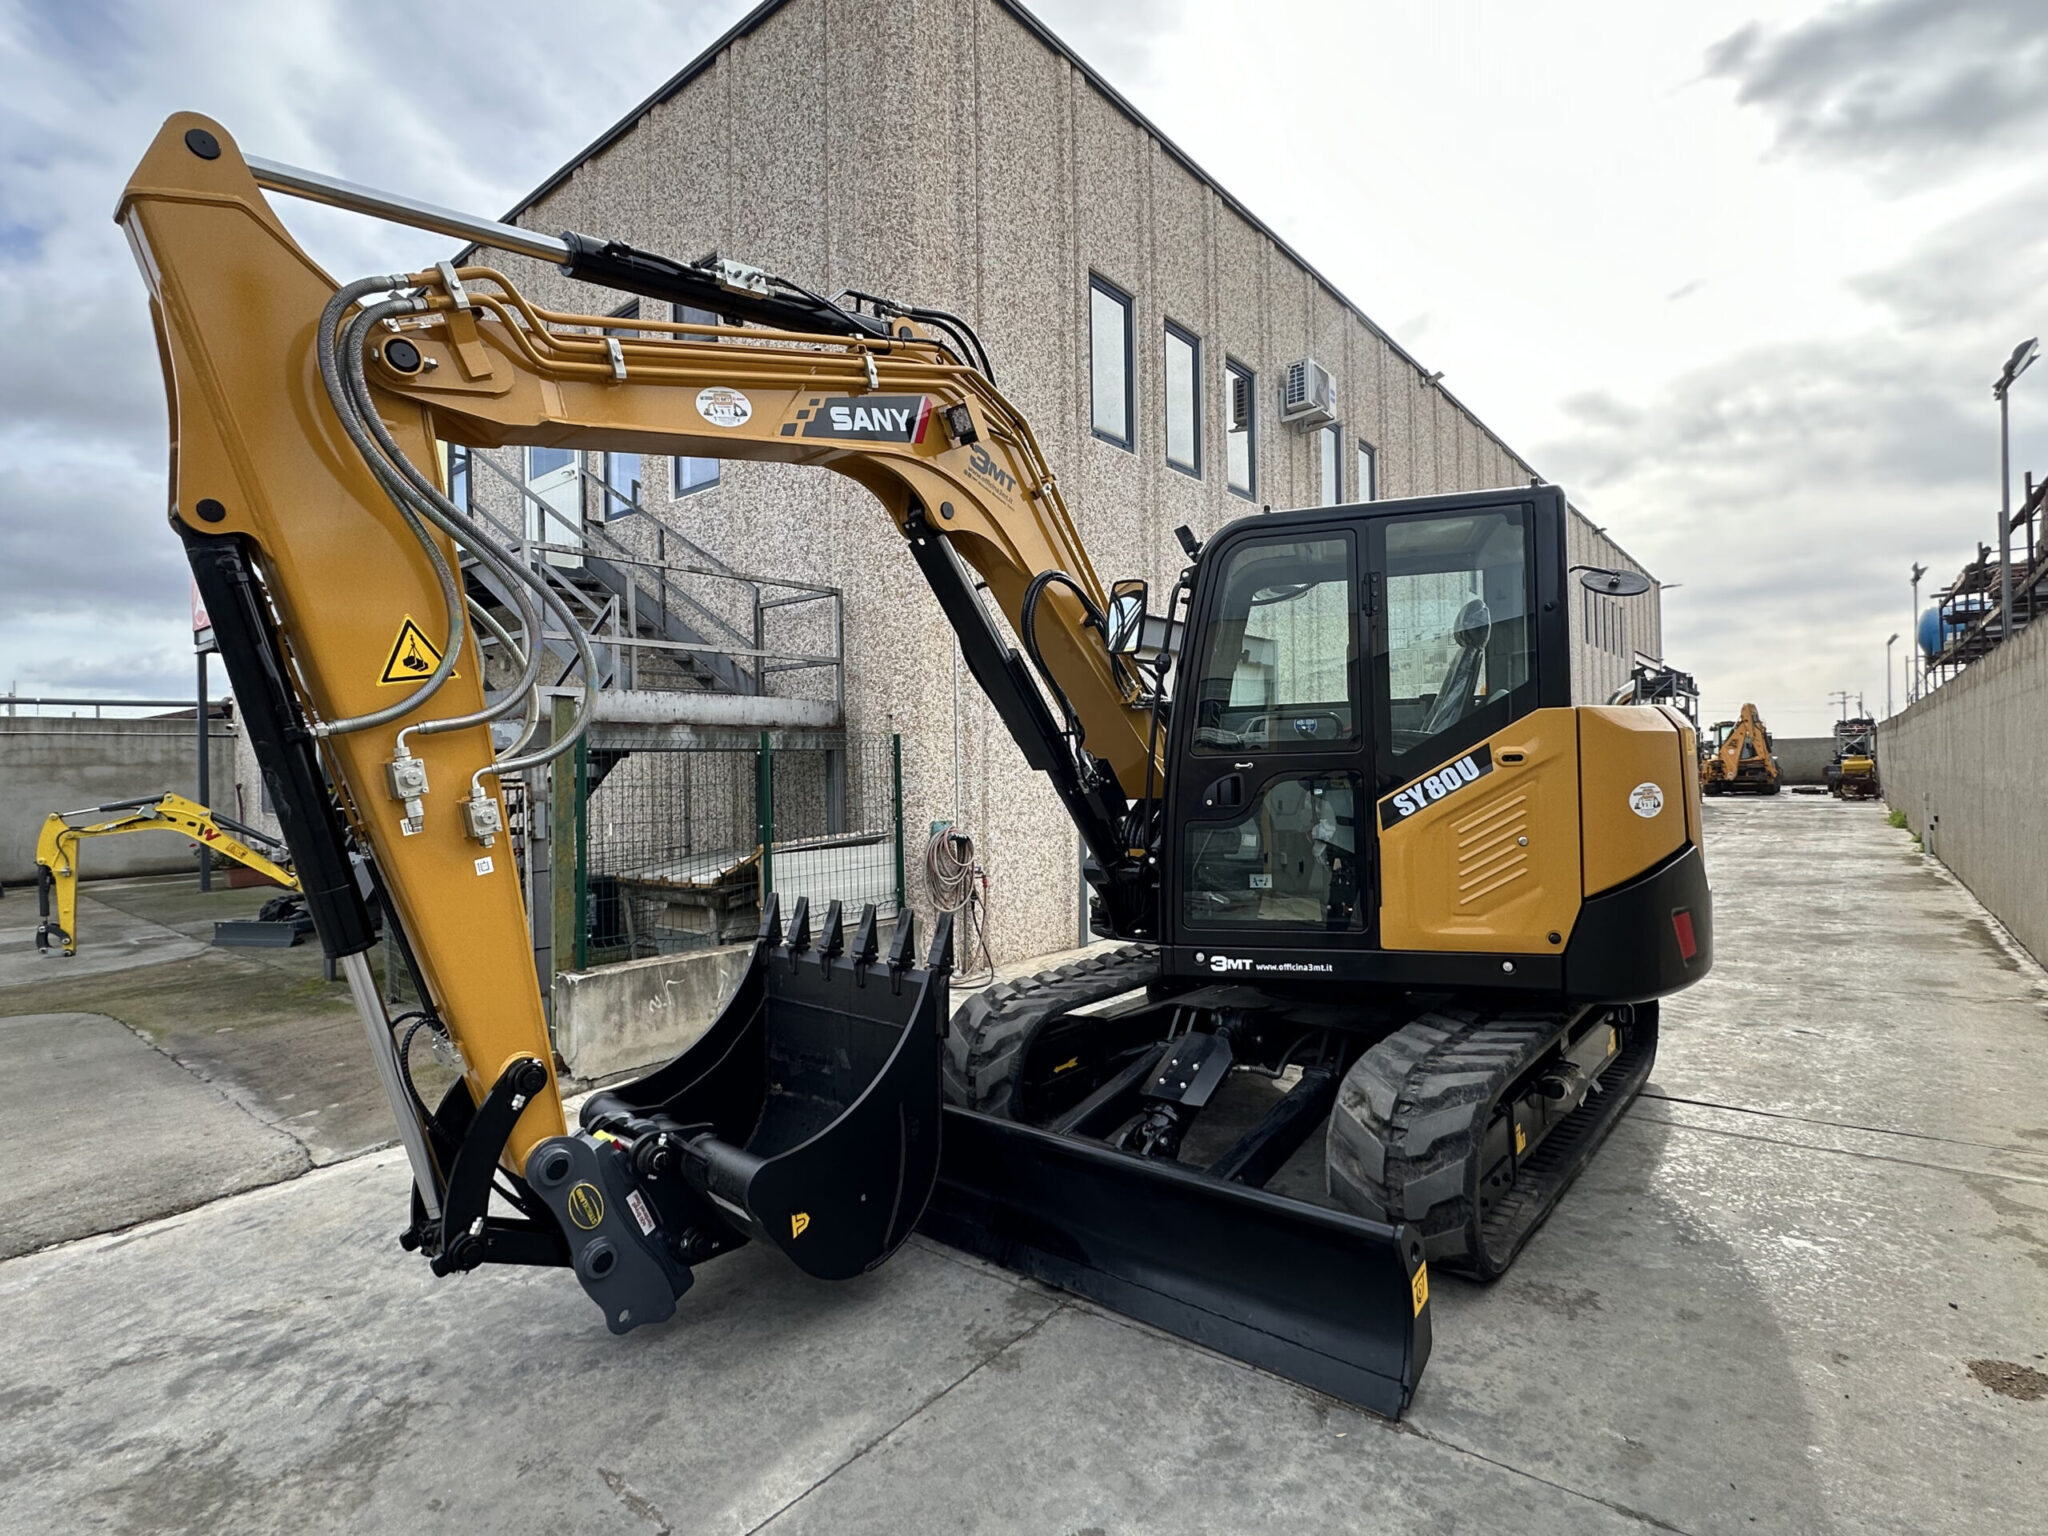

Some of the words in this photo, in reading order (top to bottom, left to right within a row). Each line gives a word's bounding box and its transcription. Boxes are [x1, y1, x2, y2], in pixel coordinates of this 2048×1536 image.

[830, 406, 910, 431] SANY
[970, 444, 1017, 492] 3MT
[1393, 755, 1479, 816] SY80U
[1210, 956, 1253, 971] 3MT
[1256, 963, 1332, 972] www.officina3mt.it
